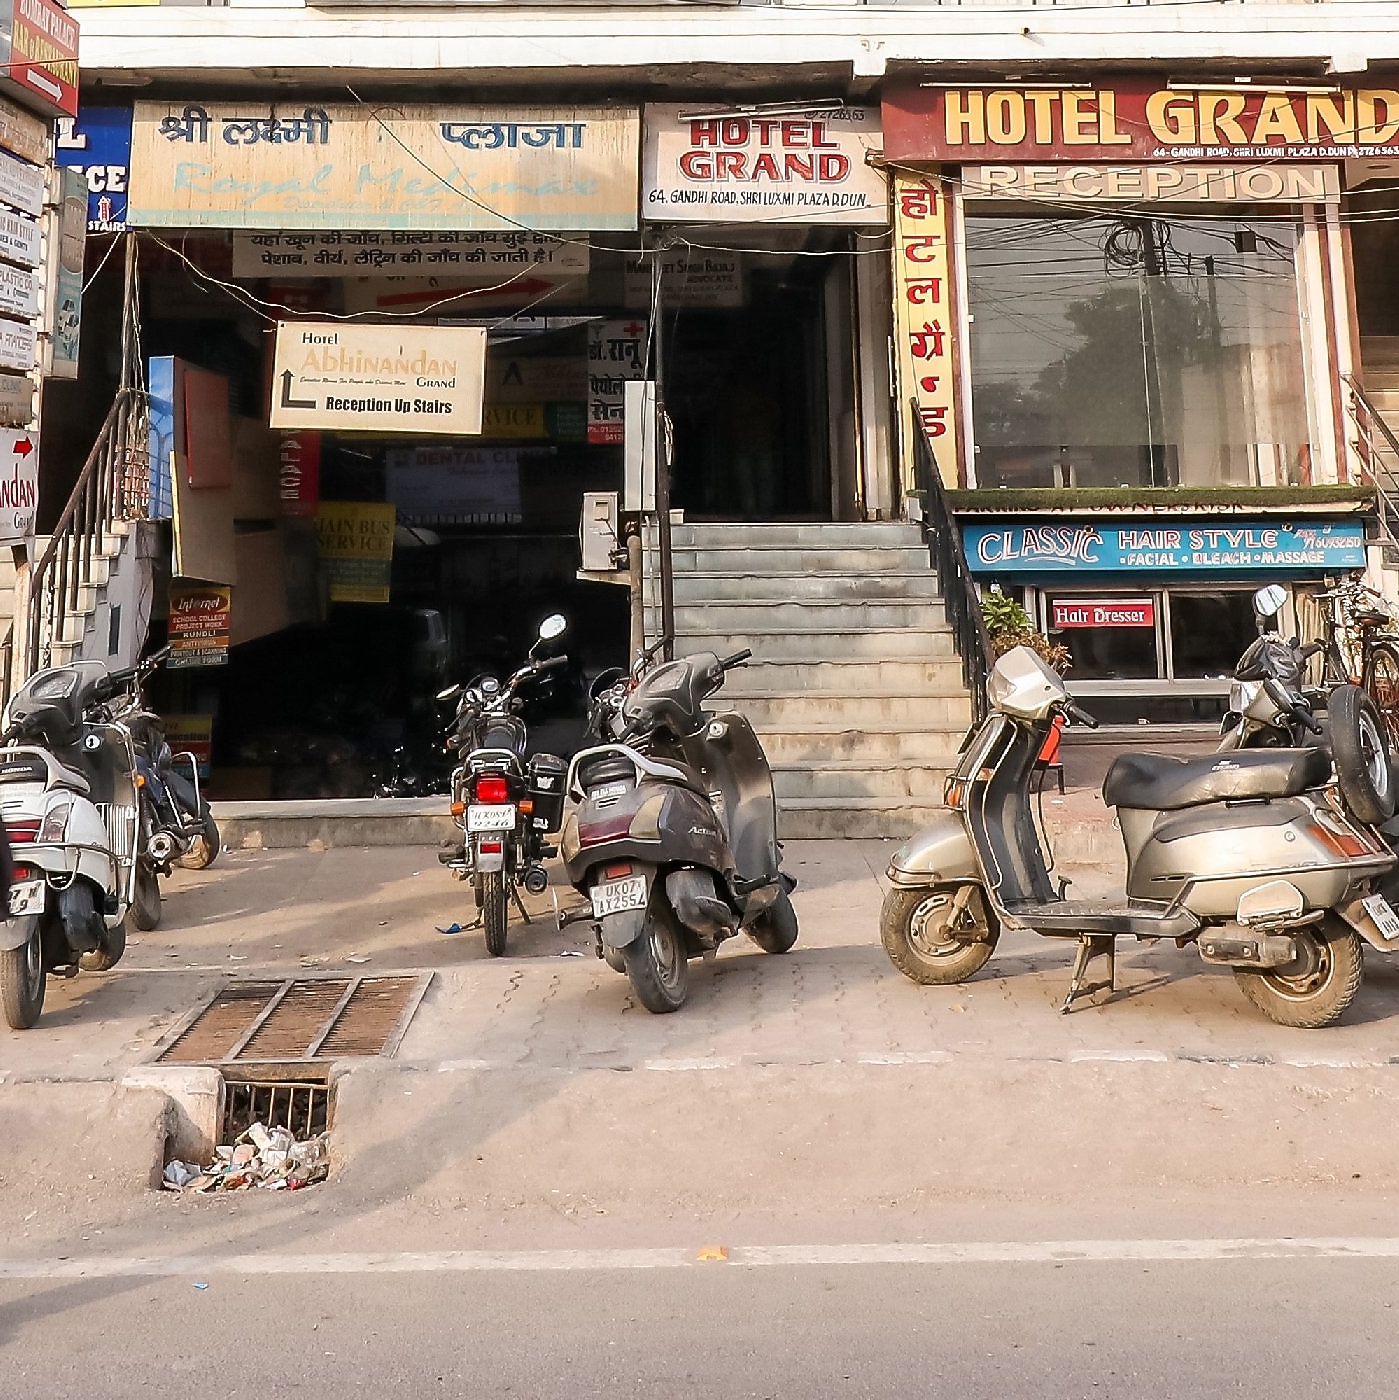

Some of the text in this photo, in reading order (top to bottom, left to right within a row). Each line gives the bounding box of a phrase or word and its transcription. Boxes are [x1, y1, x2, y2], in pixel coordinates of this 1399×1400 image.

[158, 106, 209, 143] श्री
[440, 120, 587, 150] प्लाजा
[943, 89, 1133, 146] HOTEL
[689, 118, 840, 149] HOTEL
[678, 151, 852, 183] GRAND
[980, 163, 1327, 201] RECEPTION
[670, 190, 830, 206] GANDHI SHRI LUXMI PLAZA
[401, 247, 423, 264] की
[465, 246, 487, 264] की
[490, 246, 530, 263] जाती
[326, 396, 453, 415] Reception Up Stairs
[976, 525, 1104, 565] CLASSIC
[1118, 528, 1182, 550] HAIR
[1189, 528, 1279, 550] STYLE
[1126, 550, 1326, 566] FACIAL BLEACH MASSAGE
[1055, 607, 1146, 625] Hair Dresser
